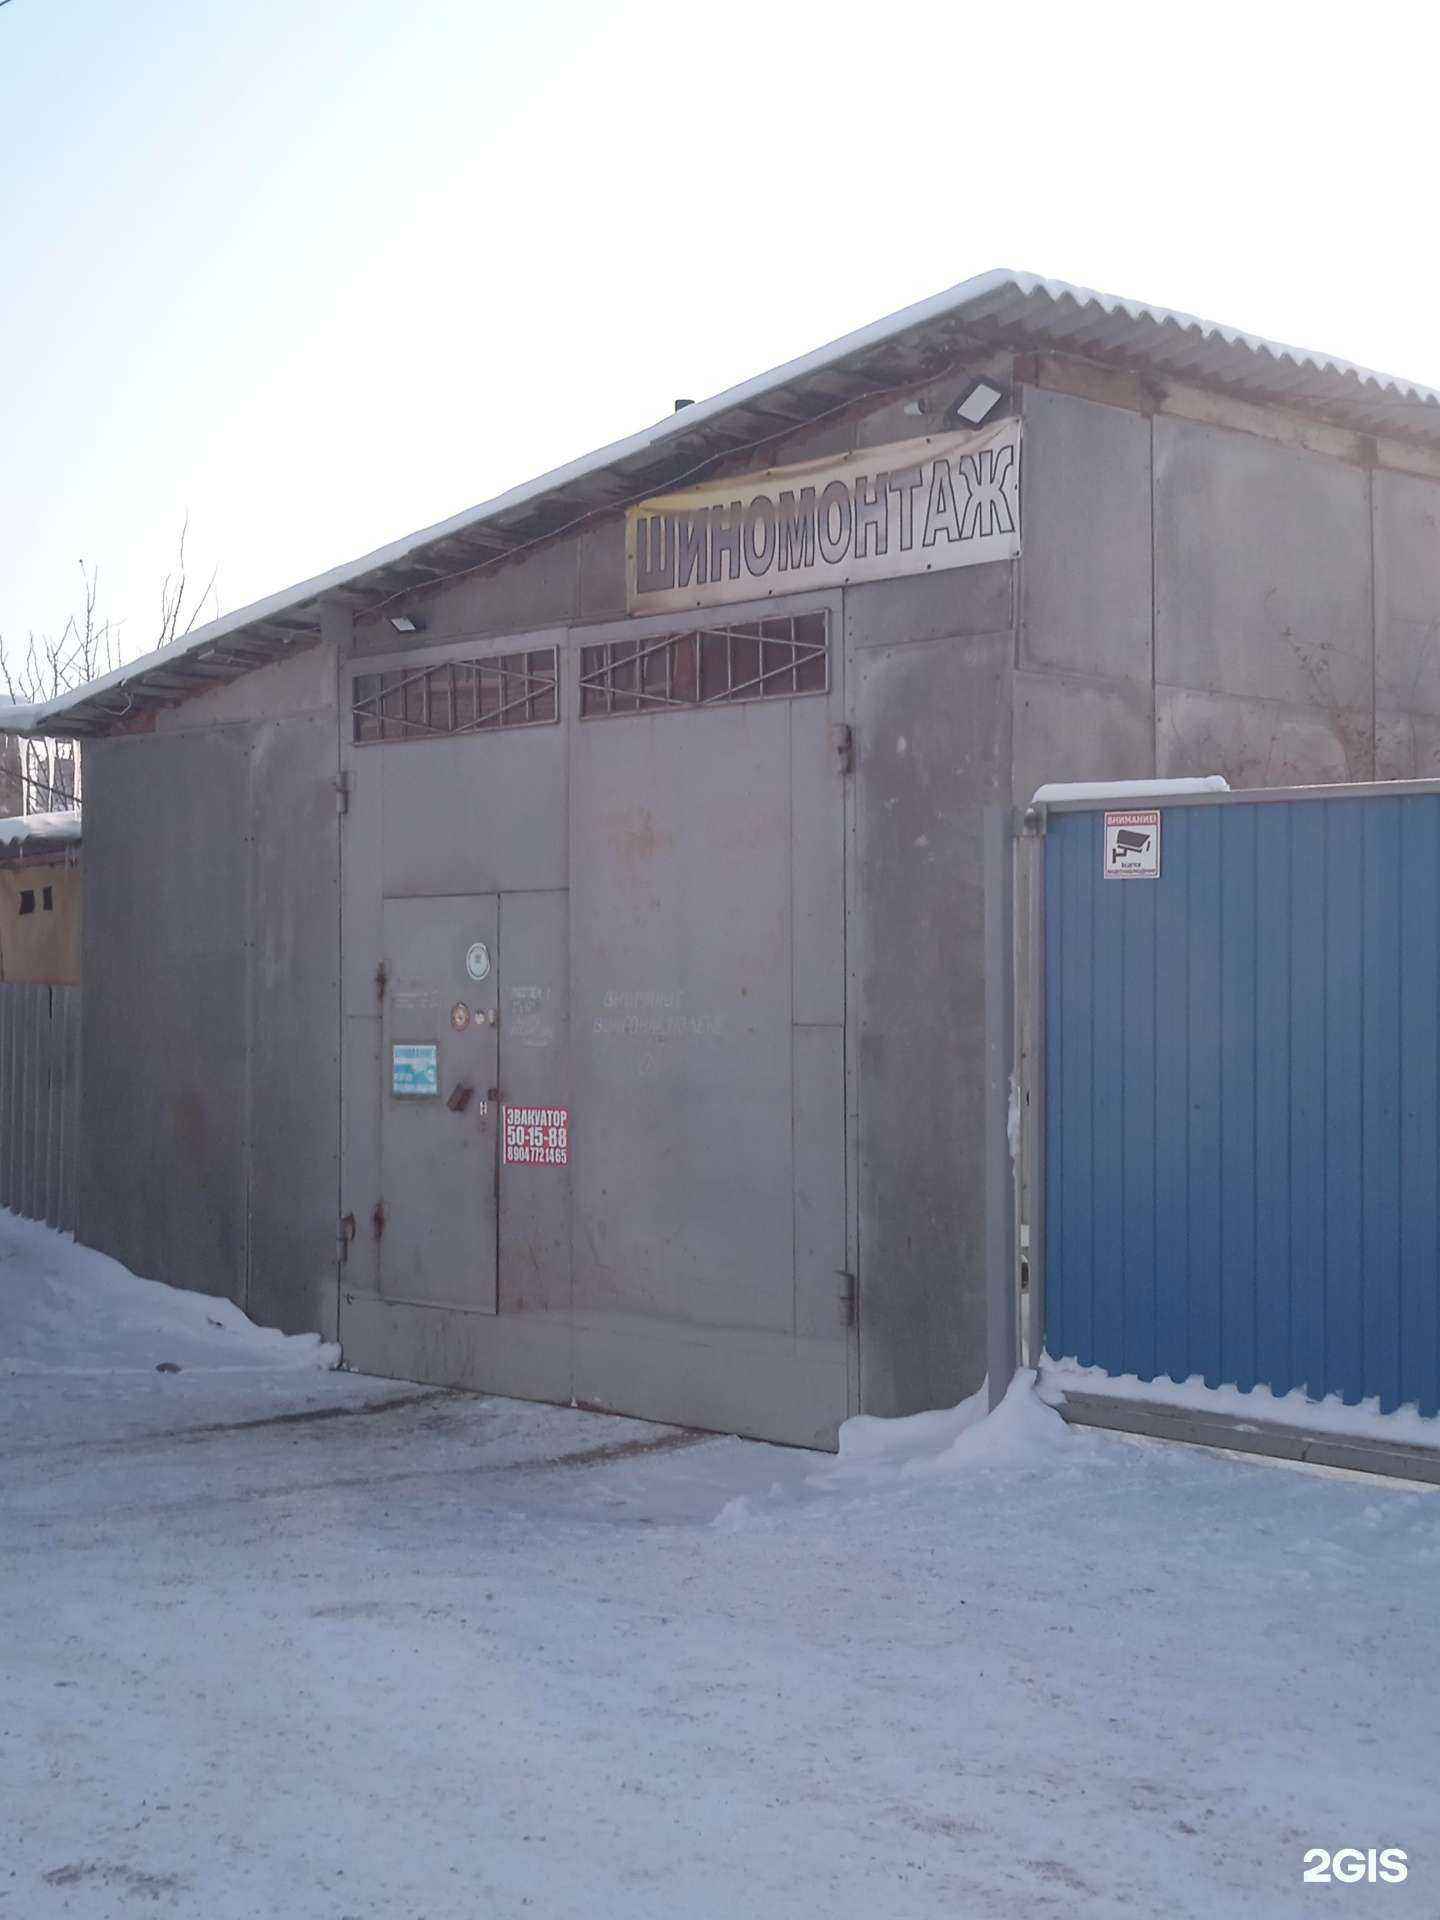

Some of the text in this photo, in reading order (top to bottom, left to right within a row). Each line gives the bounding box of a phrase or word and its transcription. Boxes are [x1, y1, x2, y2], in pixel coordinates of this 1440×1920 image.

[637, 445, 1016, 594] ШИНОМОНТАЖ
[507, 1108, 567, 1127] ЭВАКУАТОР
[507, 1125, 567, 1148] 50-15-88
